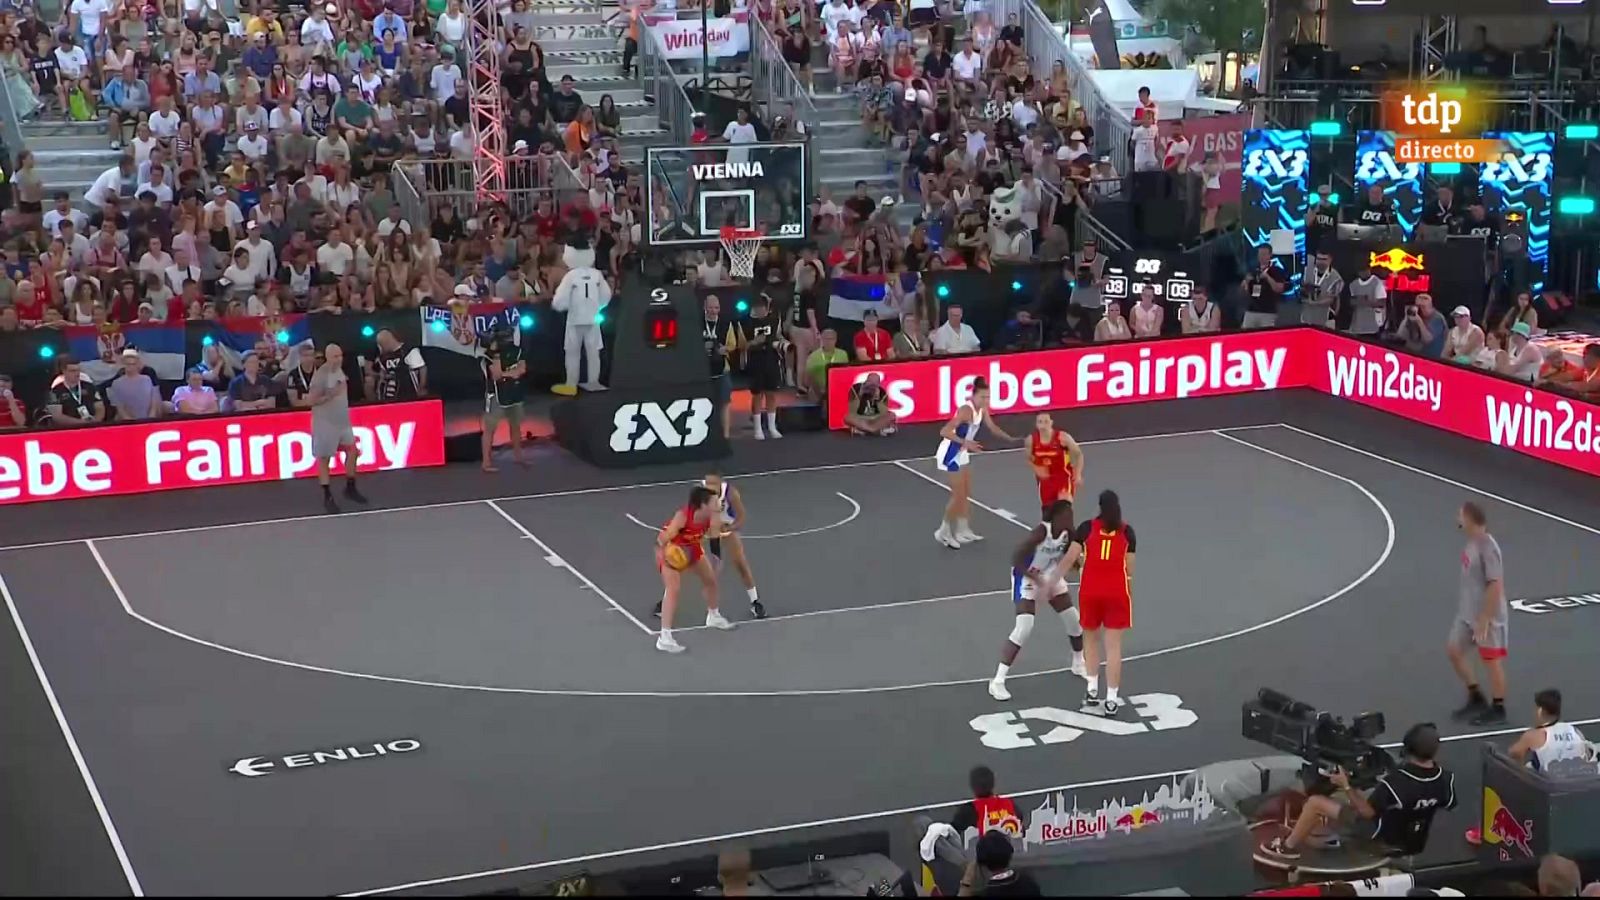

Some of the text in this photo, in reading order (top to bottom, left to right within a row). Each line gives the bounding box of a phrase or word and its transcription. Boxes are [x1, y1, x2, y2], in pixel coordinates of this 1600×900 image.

[692, 161, 764, 181] VIENNA
[1077, 341, 1288, 402] Fairplay
[146, 421, 417, 485] Fairpay
[1101, 539, 1112, 560] 11
[283, 739, 420, 767] ENLIO
[1042, 820, 1073, 840] Red
[1076, 815, 1106, 835] Bull
